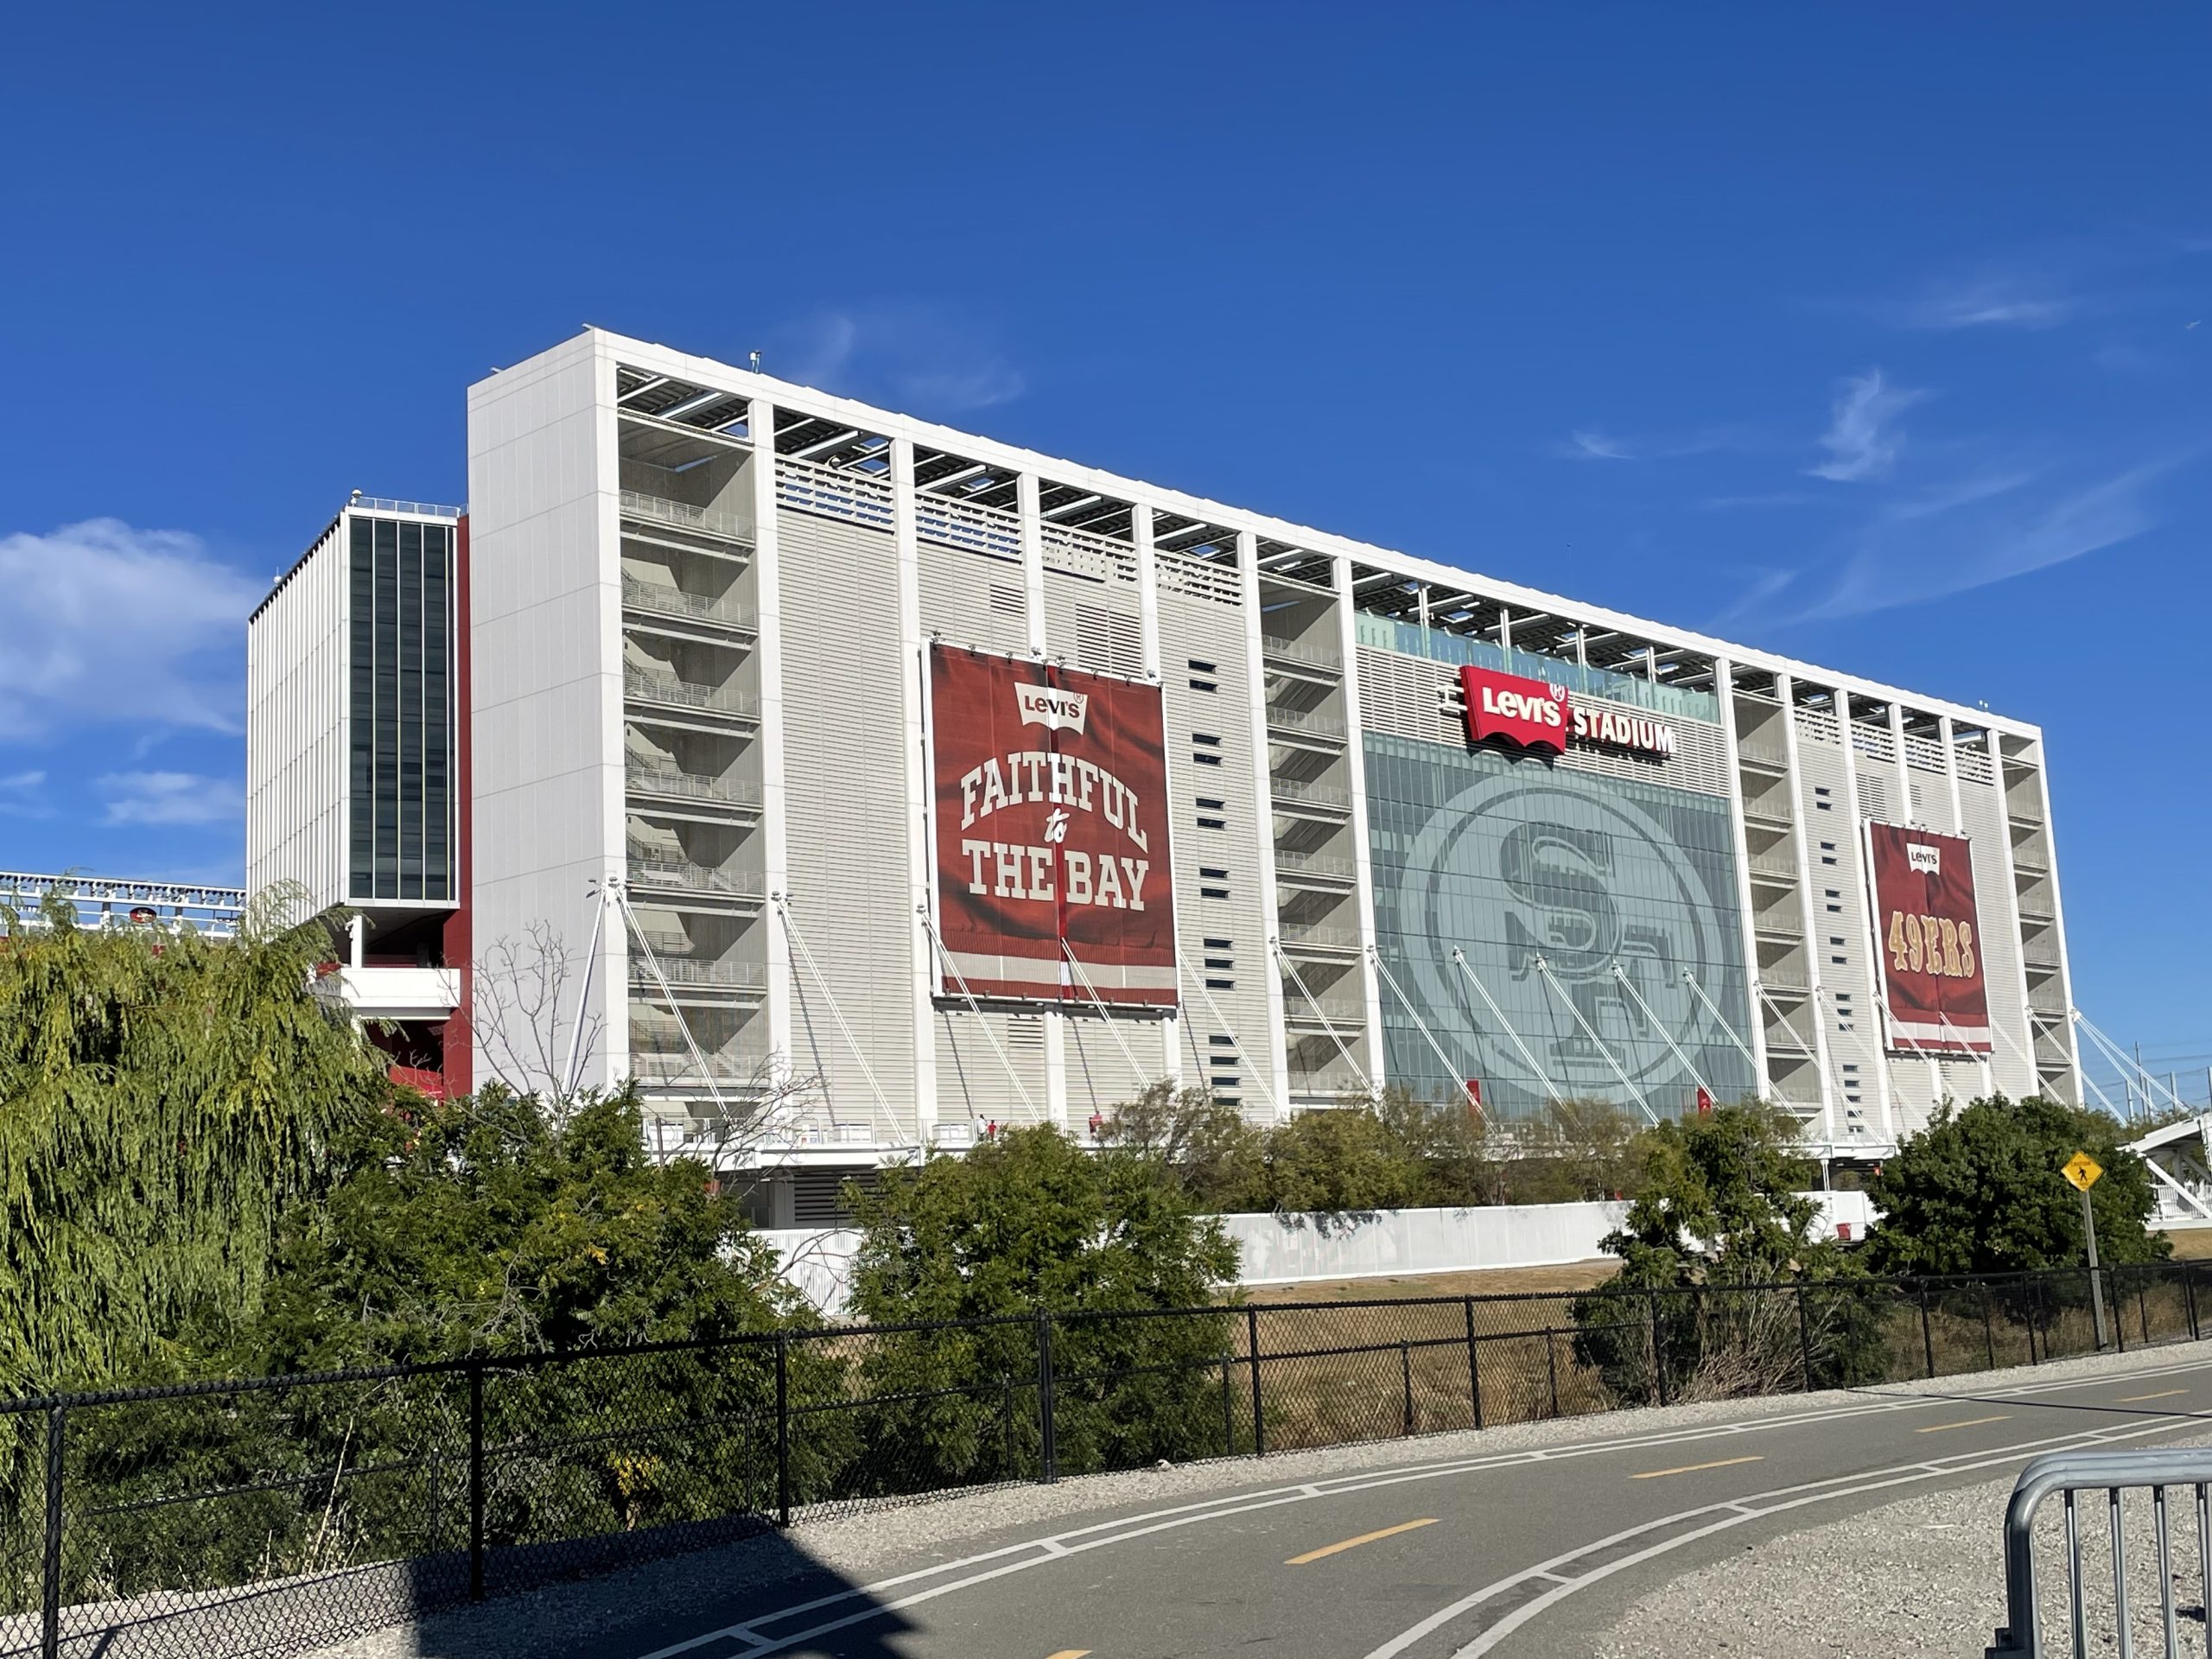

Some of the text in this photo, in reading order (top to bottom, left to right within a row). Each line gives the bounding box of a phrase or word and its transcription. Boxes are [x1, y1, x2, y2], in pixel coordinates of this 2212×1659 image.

[1573, 707, 1676, 753] STADIUM
[960, 751, 1148, 854] FAITHFUL
[1044, 807, 1070, 844] to
[961, 838, 1150, 912] THE BAY
[1888, 910, 1975, 978] 49ERS
